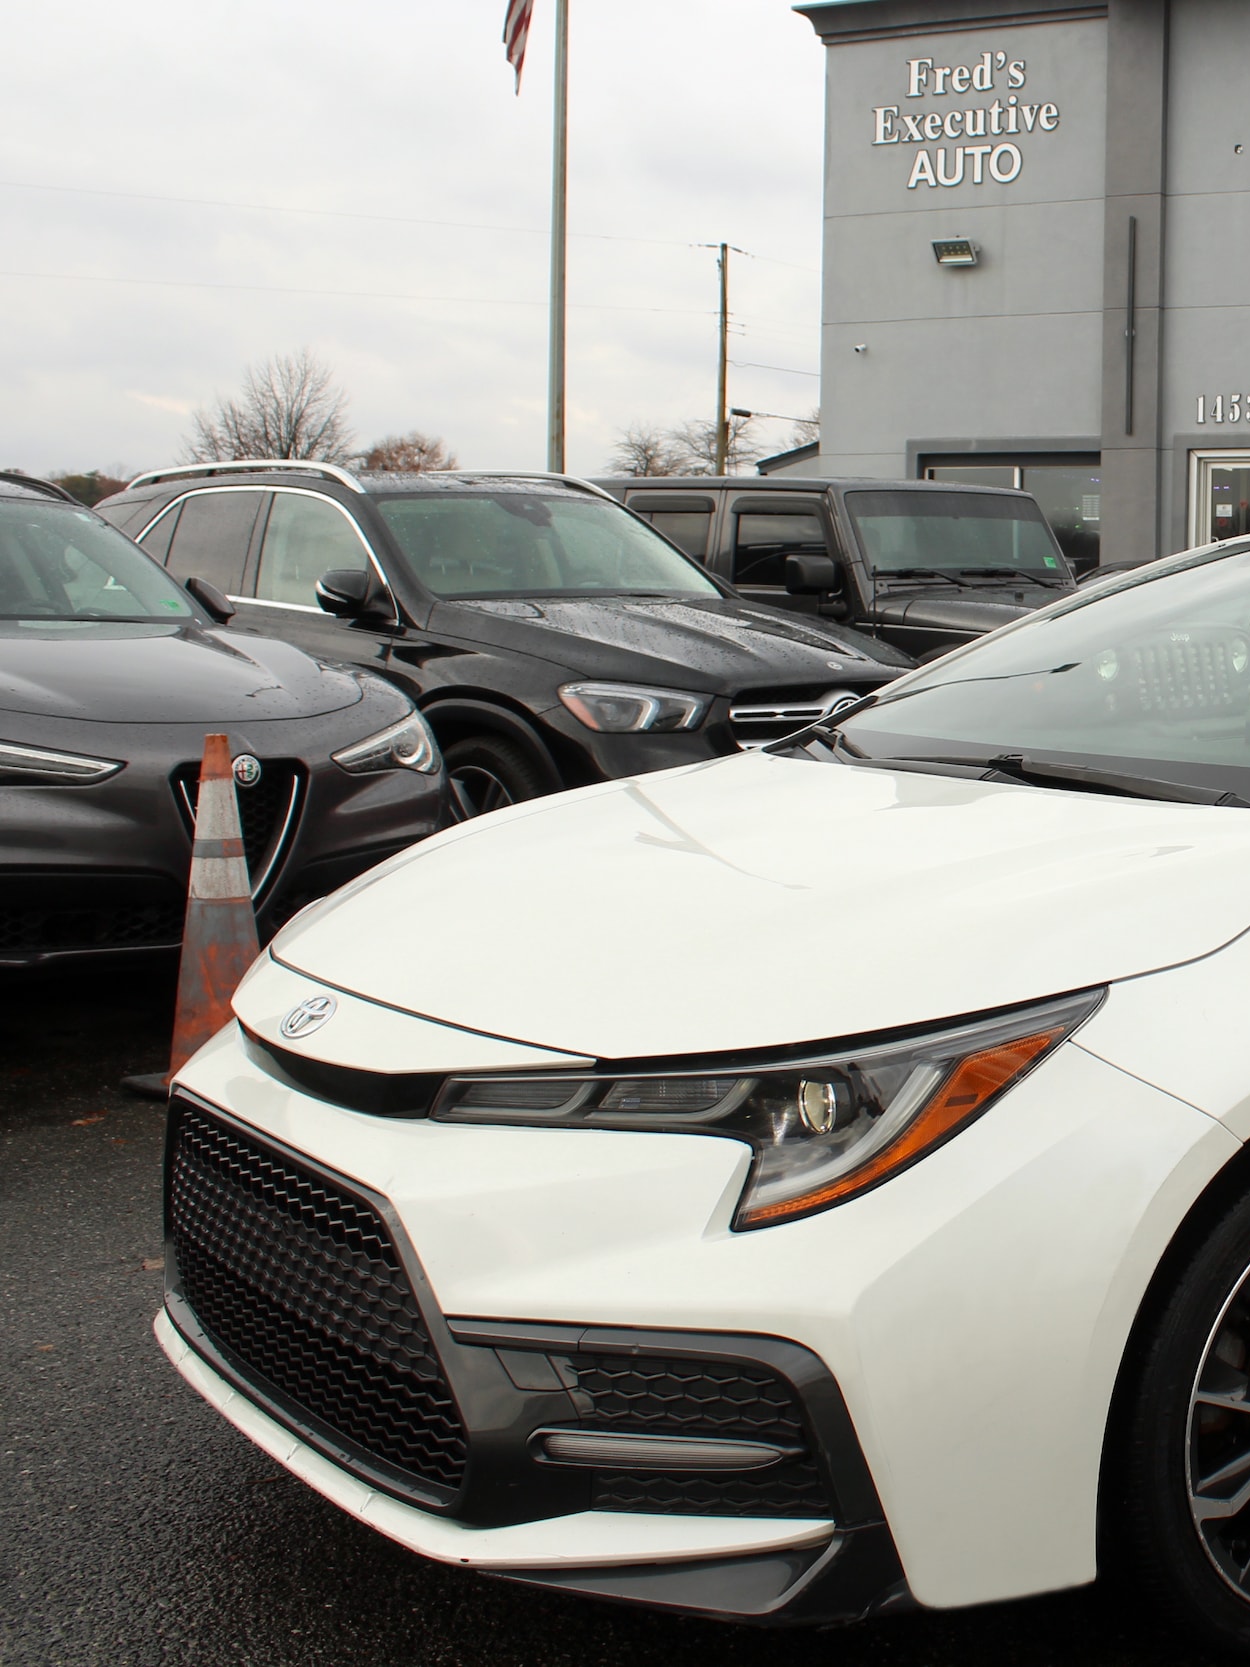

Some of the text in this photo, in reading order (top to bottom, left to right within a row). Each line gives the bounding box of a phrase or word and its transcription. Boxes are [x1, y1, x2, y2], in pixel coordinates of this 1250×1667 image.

[906, 51, 1026, 98] Fred's
[872, 96, 1059, 145] Executive
[907, 142, 1022, 188] AUTO
